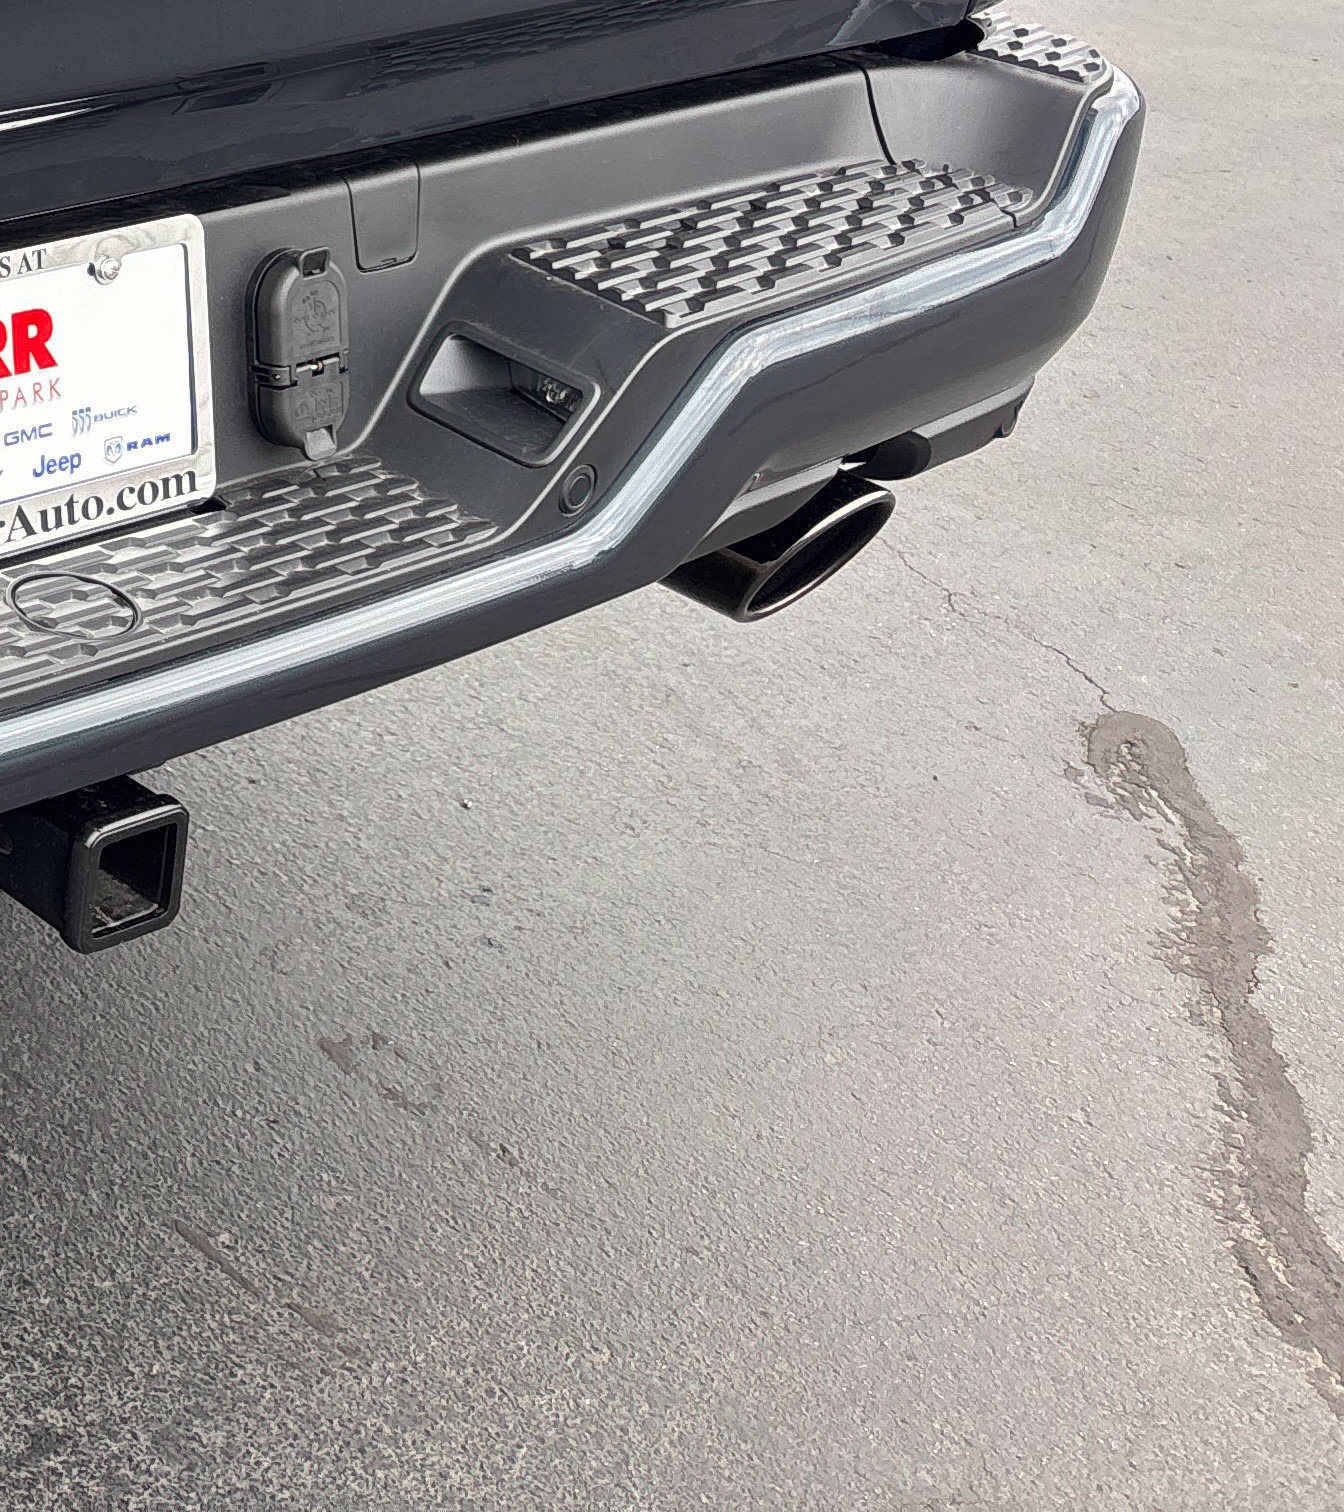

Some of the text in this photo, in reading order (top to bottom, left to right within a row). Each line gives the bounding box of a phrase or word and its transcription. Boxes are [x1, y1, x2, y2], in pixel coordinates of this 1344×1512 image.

[18, 248, 47, 274] AT
[0, 377, 62, 413] PARK
[4, 423, 53, 447] GMC
[93, 404, 138, 422] BUICK
[32, 452, 82, 478] Jeep
[126, 432, 171, 452] RAM
